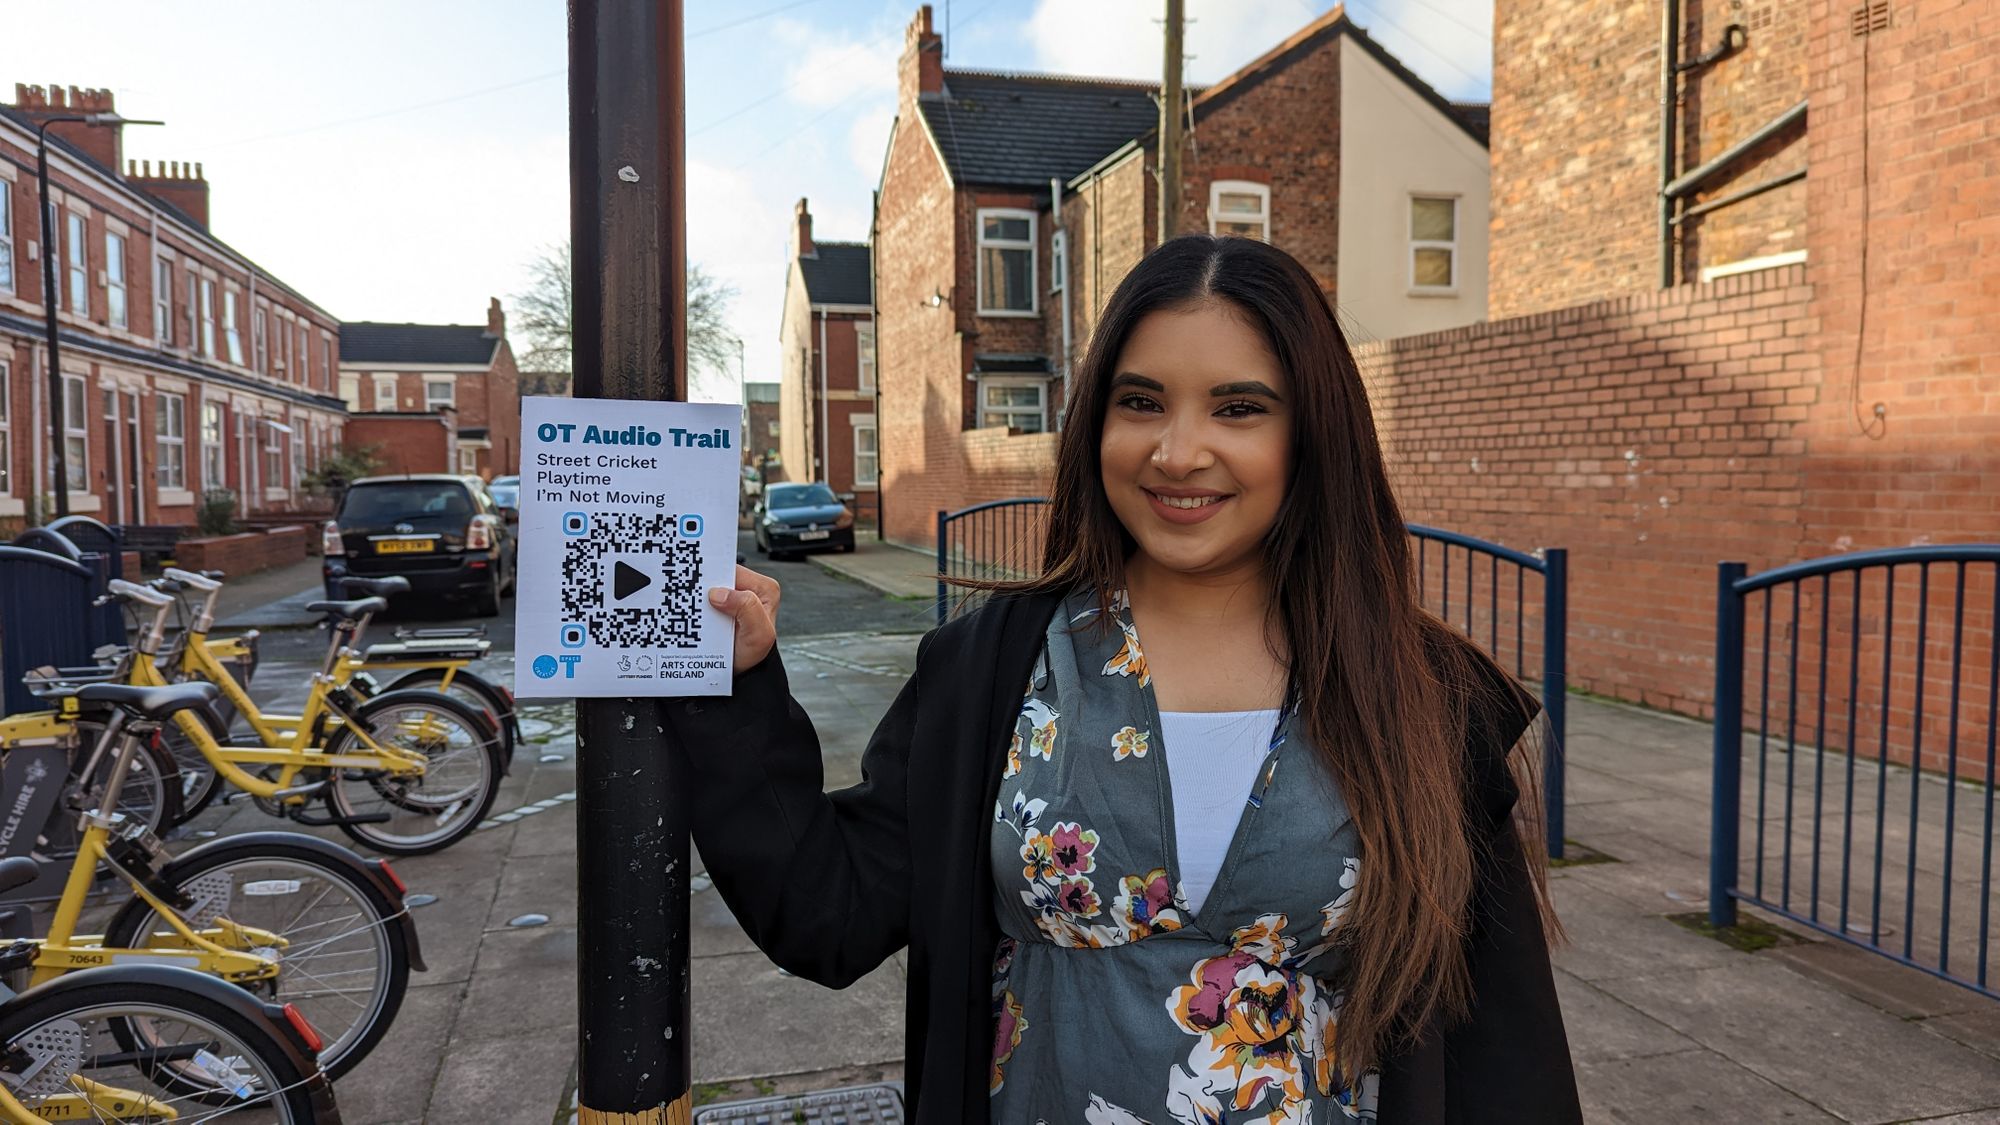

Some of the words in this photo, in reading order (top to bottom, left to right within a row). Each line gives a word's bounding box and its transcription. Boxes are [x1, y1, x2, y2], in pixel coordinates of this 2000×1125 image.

[537, 423, 576, 443] OT
[582, 425, 662, 446] Audio
[668, 428, 731, 449] Trail
[537, 453, 591, 467] Street
[597, 455, 658, 469] Cricket
[537, 470, 612, 487] Playtime
[569, 490, 600, 503] Not
[606, 491, 666, 508] Moving
[660, 661, 684, 669] ARTS
[687, 661, 727, 669] COUNCIL
[660, 671, 705, 679] ENGLAND
[11, 784, 36, 816] HIRE
[69, 954, 104, 964] 70643
